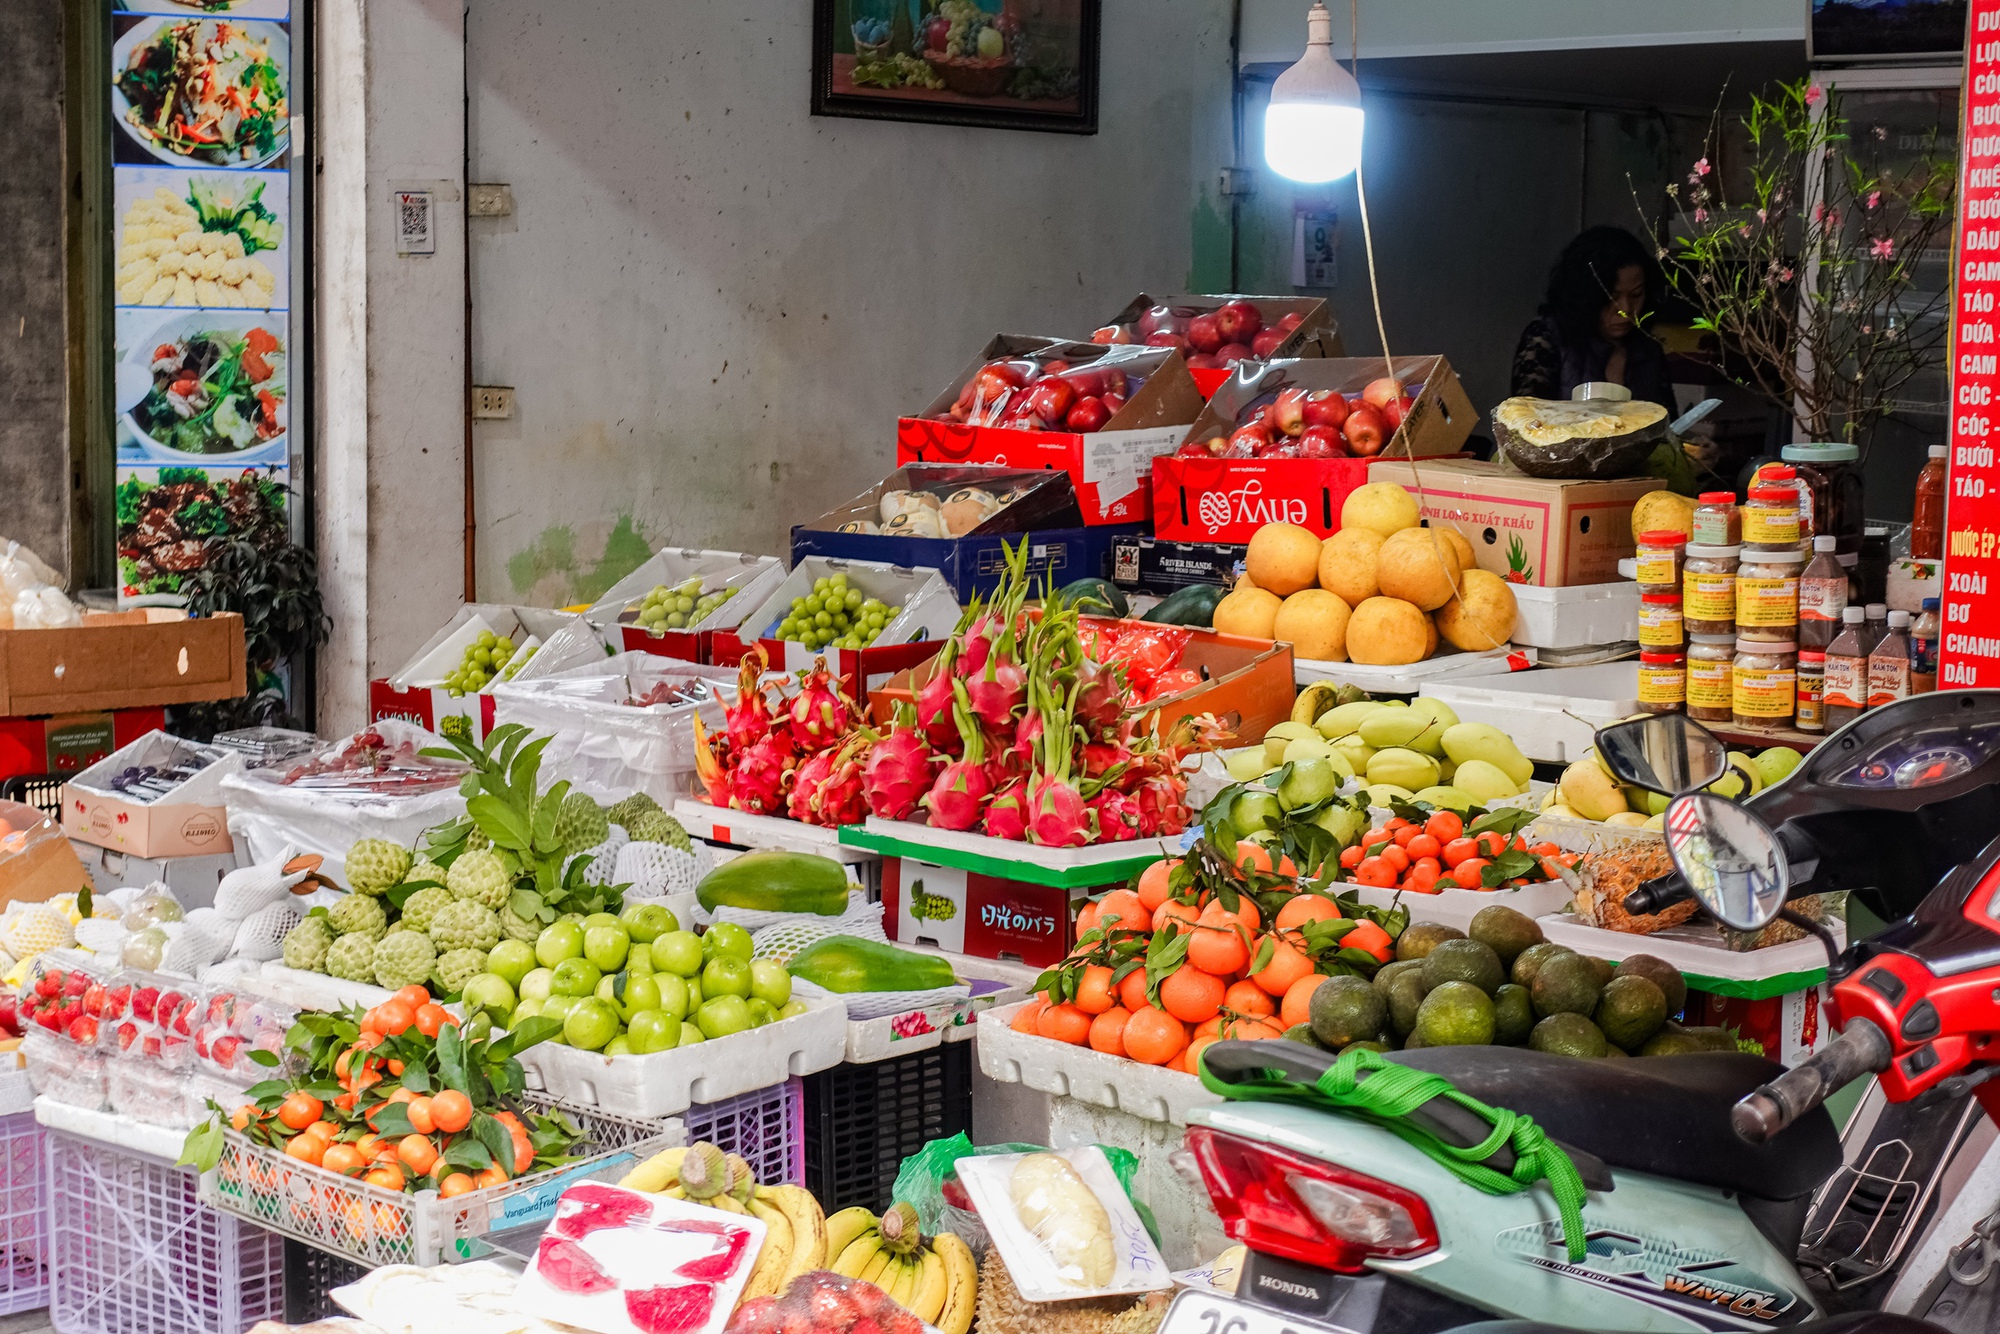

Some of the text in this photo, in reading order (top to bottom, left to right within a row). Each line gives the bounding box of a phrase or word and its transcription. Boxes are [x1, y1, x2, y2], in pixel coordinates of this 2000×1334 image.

[1978, 11, 2000, 32] DƯ
[1314, 227, 1326, 252] 9
[1964, 261, 2000, 282] CAM
[1963, 289, 1994, 313] TÁO
[1961, 318, 1994, 344] DỨA
[1960, 354, 1997, 375] CAM
[1959, 382, 1991, 406] CÓC
[1957, 412, 1990, 436] CÓC
[1955, 440, 1993, 468] BƯỞI
[1954, 474, 1985, 499] TÁO
[1228, 479, 1308, 525] envy
[1420, 505, 1535, 531] ANH LONG XUẤT KHẨU
[1950, 524, 1996, 559] NƯỚC ÉP
[1185, 560, 1213, 571] ISLANDS
[1949, 571, 1987, 595] XOÀI
[1947, 602, 1971, 624] BƠ
[1946, 632, 2000, 659] CHANH
[1943, 661, 1977, 686] DÂU
[981, 904, 1055, 936] 日光のバラ
[1258, 1274, 1320, 1300] HONDA
